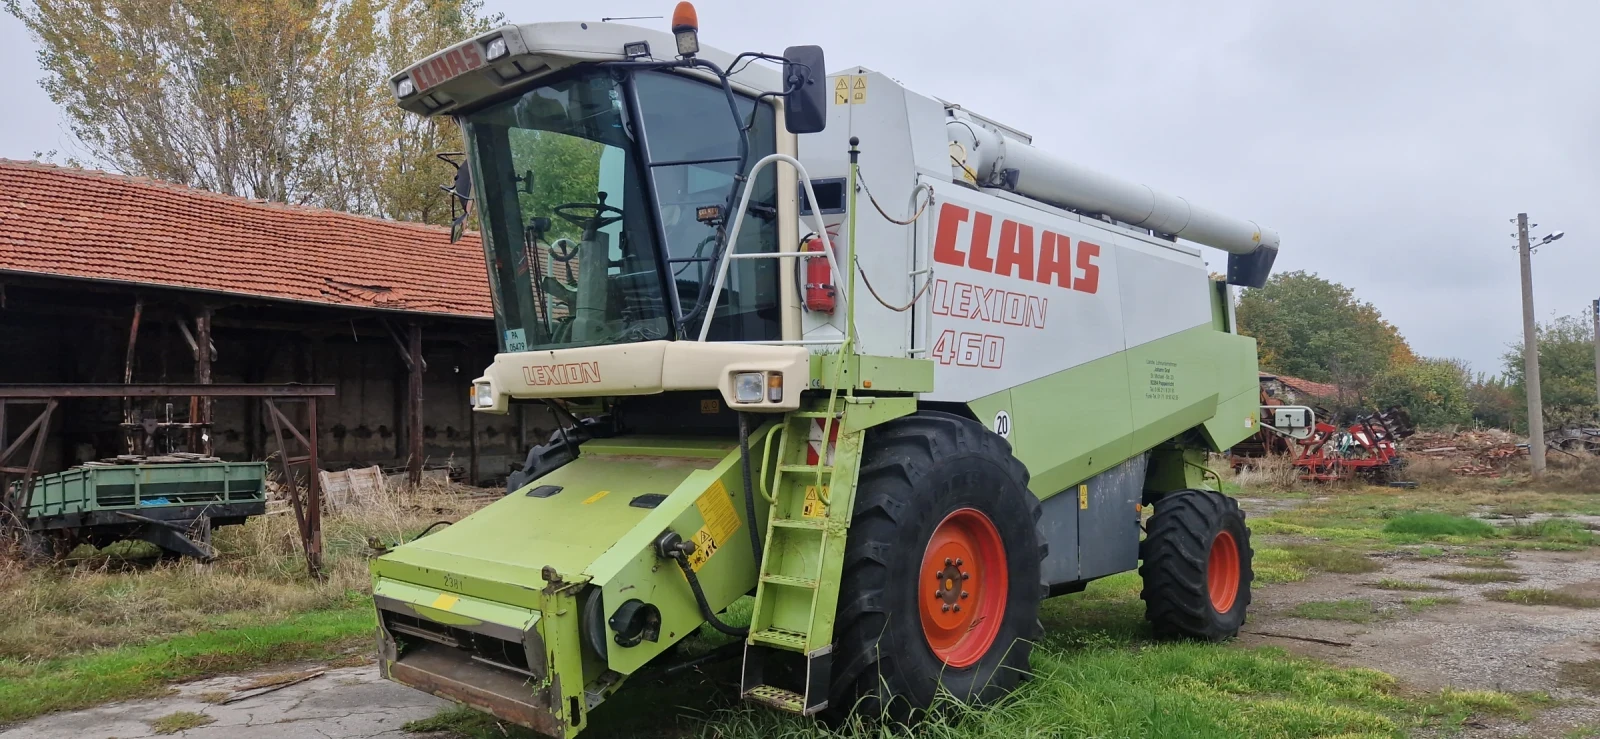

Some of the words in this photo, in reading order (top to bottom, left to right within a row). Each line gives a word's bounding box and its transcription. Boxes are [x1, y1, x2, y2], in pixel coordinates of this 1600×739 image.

[411, 43, 481, 91] CLAAS
[933, 202, 1100, 294] CLAAS
[932, 279, 1048, 329] LEXION
[511, 331, 518, 339] PA
[932, 330, 1005, 369] 460
[522, 361, 601, 385] LEXION
[997, 414, 1008, 435] 20
